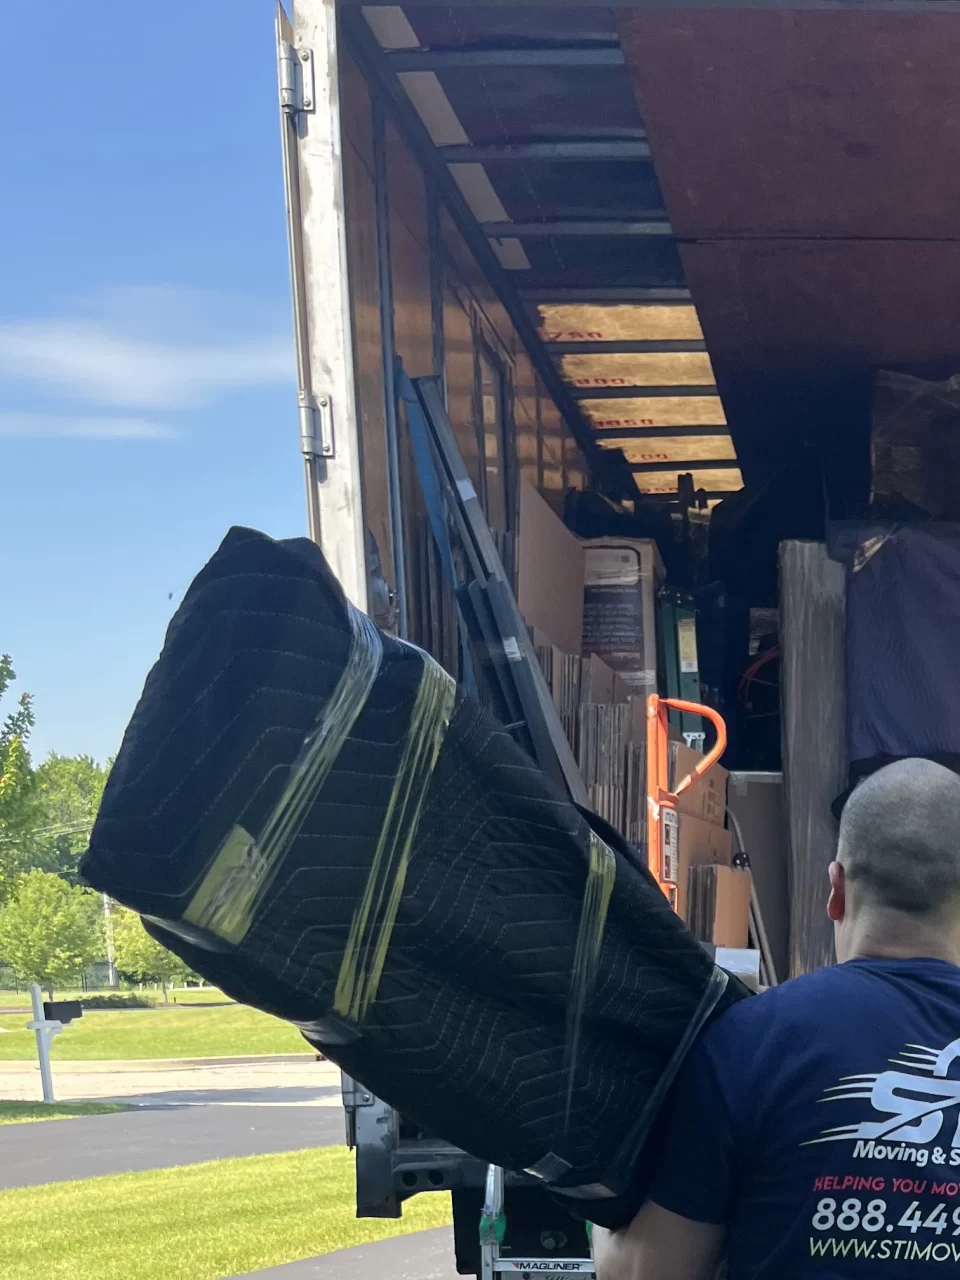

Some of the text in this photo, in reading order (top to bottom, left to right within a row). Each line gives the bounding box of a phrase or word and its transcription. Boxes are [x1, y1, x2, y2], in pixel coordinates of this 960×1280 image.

[853, 1140, 928, 1168] Moving
[931, 1147, 946, 1165] &
[813, 1176, 885, 1193] HELPING
[892, 1178, 926, 1193] YOU
[519, 1262, 580, 1271] MAGLINER
